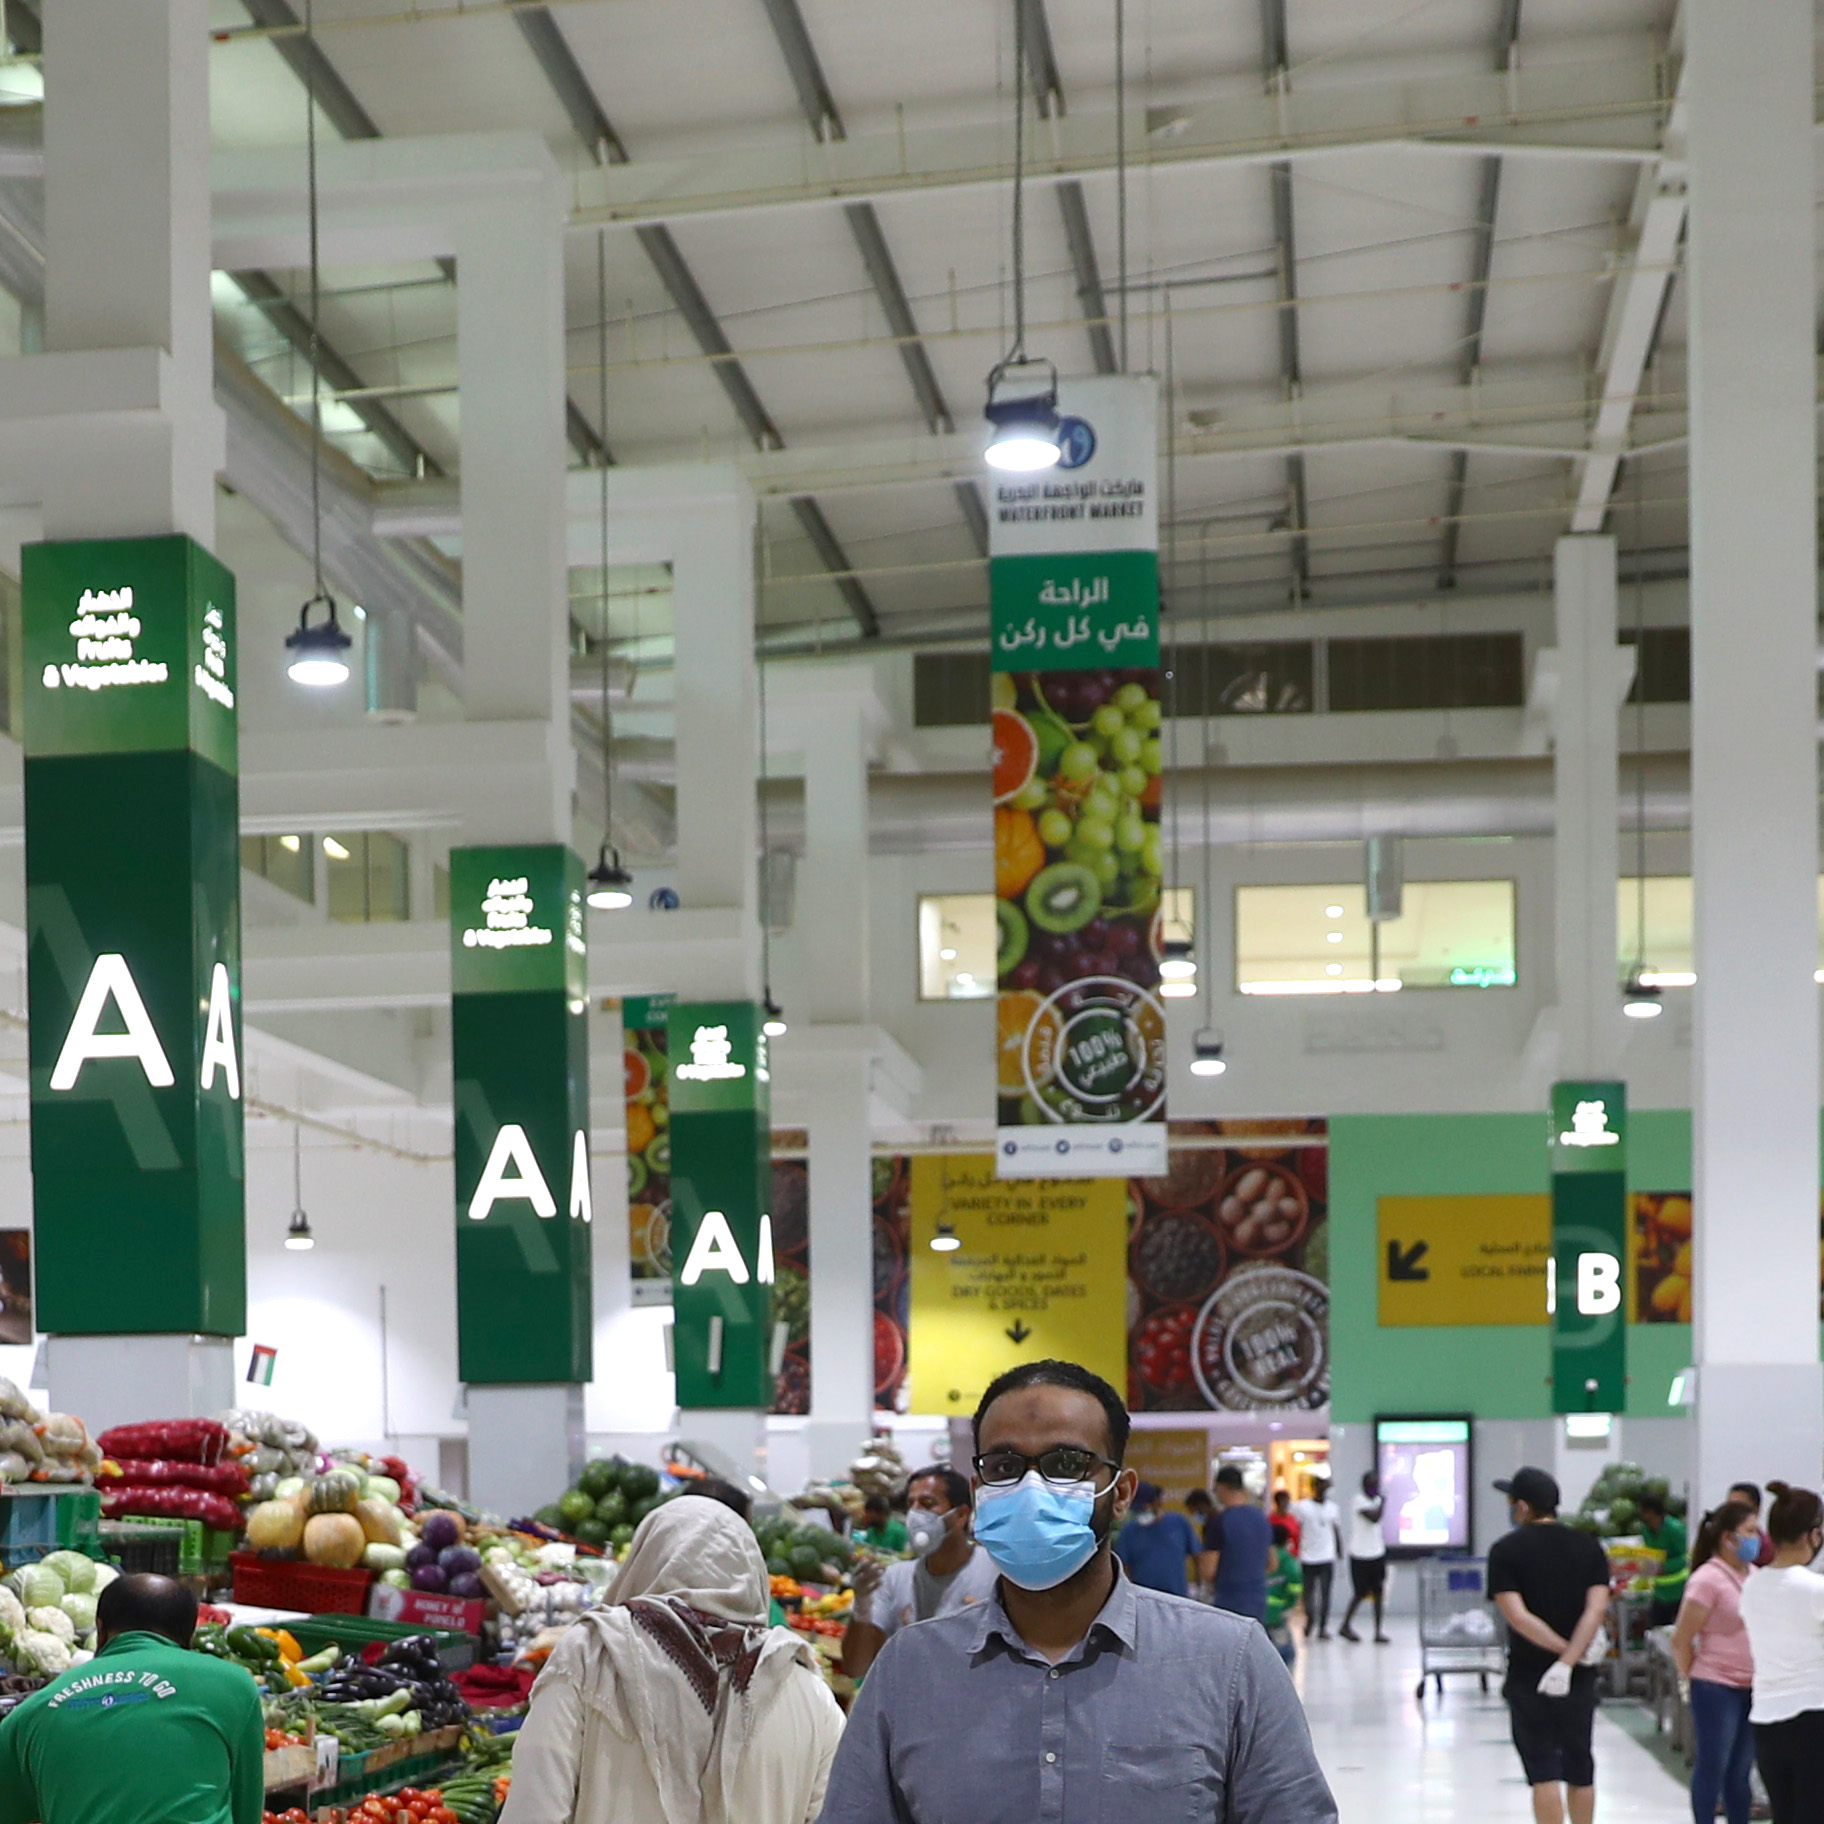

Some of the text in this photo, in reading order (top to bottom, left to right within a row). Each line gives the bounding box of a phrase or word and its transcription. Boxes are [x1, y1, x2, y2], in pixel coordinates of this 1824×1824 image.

[1039, 576, 1109, 608] الراحة
[1054, 616, 1091, 648] كل
[1097, 614, 1150, 652] في
[50, 953, 175, 1090] A
[200, 962, 240, 1100] A
[1069, 1027, 1125, 1067] 100%
[468, 1124, 557, 1220] A
[570, 1129, 592, 1223] A
[681, 1211, 749, 1285] A
[1578, 1252, 1621, 1315] B
[48, 1671, 136, 1708] FRESHNESS
[138, 1671, 160, 1688] TO
[152, 1680, 177, 1699] GO
